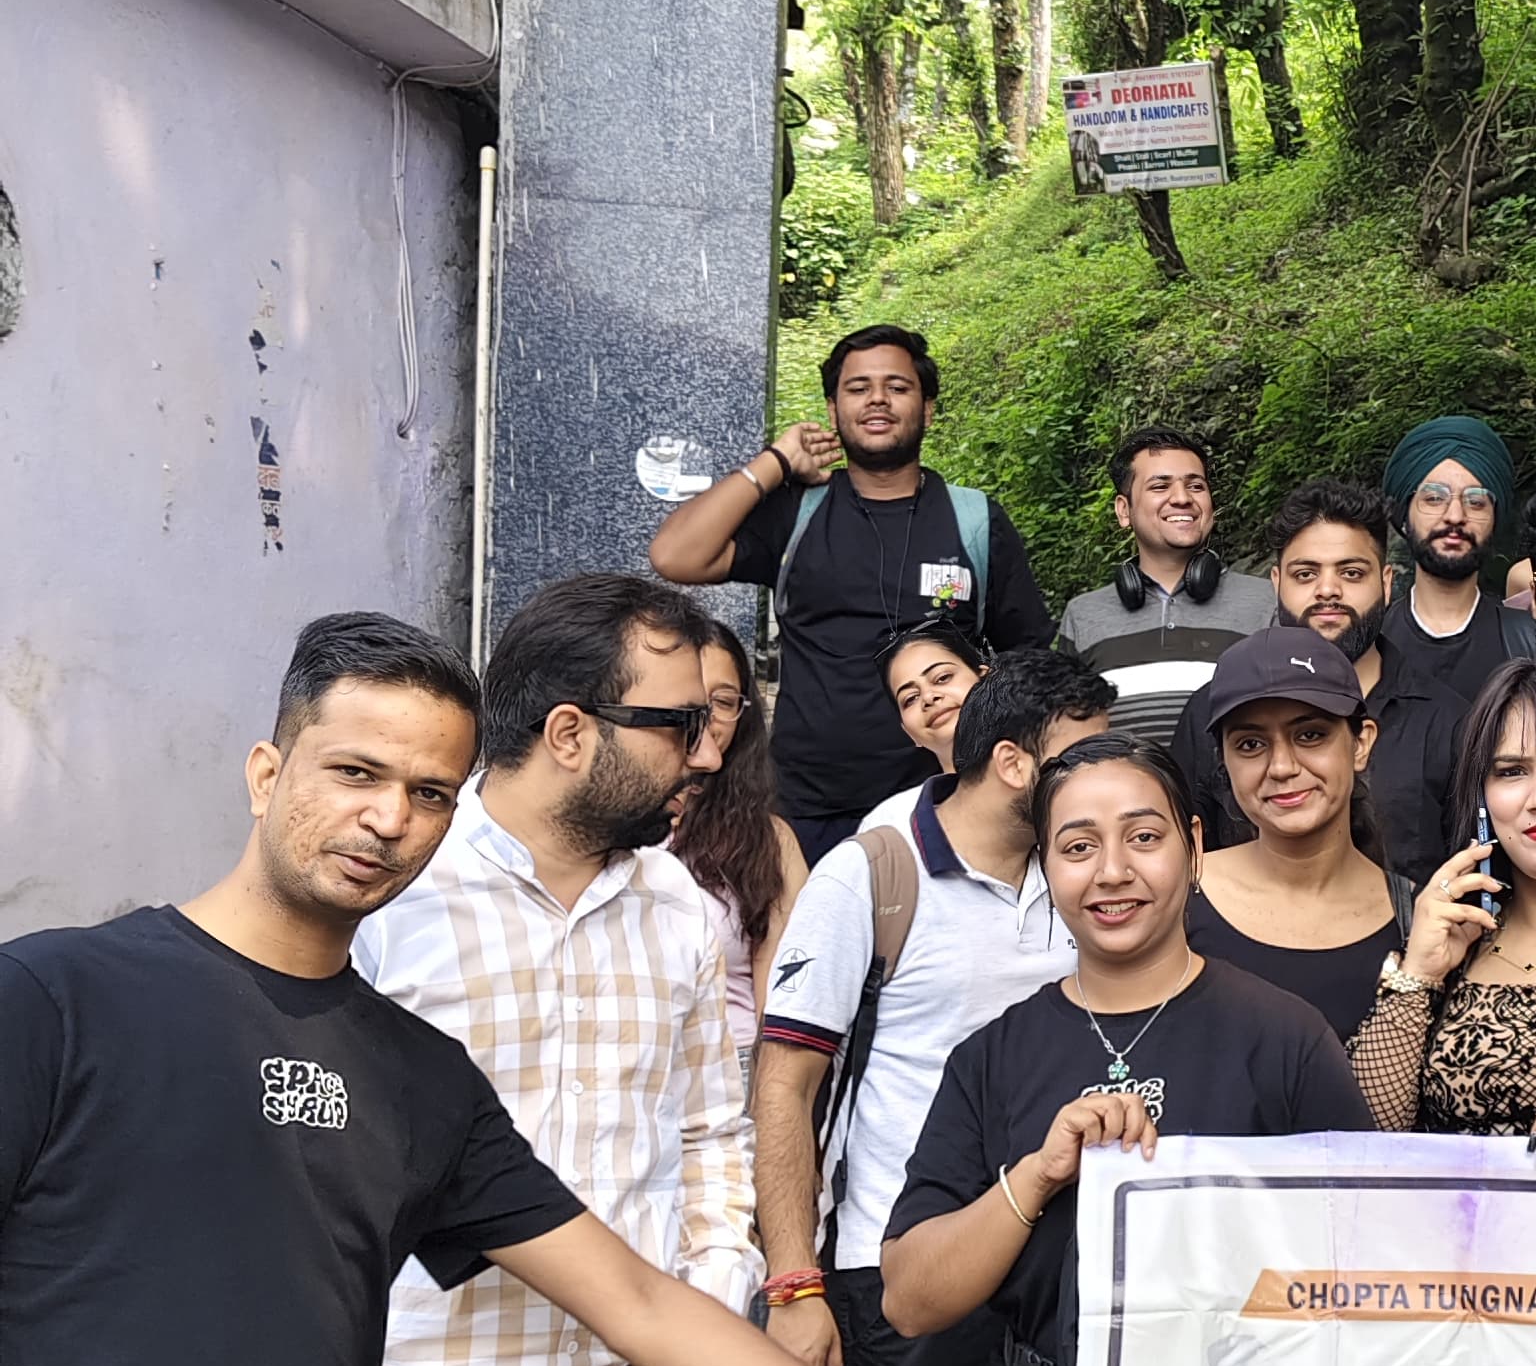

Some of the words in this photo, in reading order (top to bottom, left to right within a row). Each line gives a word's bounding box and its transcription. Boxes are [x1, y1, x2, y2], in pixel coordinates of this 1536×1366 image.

[1111, 81, 1196, 105] DEORIATAL
[1073, 109, 1127, 128] HANDLOOM
[1130, 108, 1137, 122] &
[1140, 102, 1209, 121] HANDICRAFTS
[1287, 1281, 1410, 1309] CHOPTA
